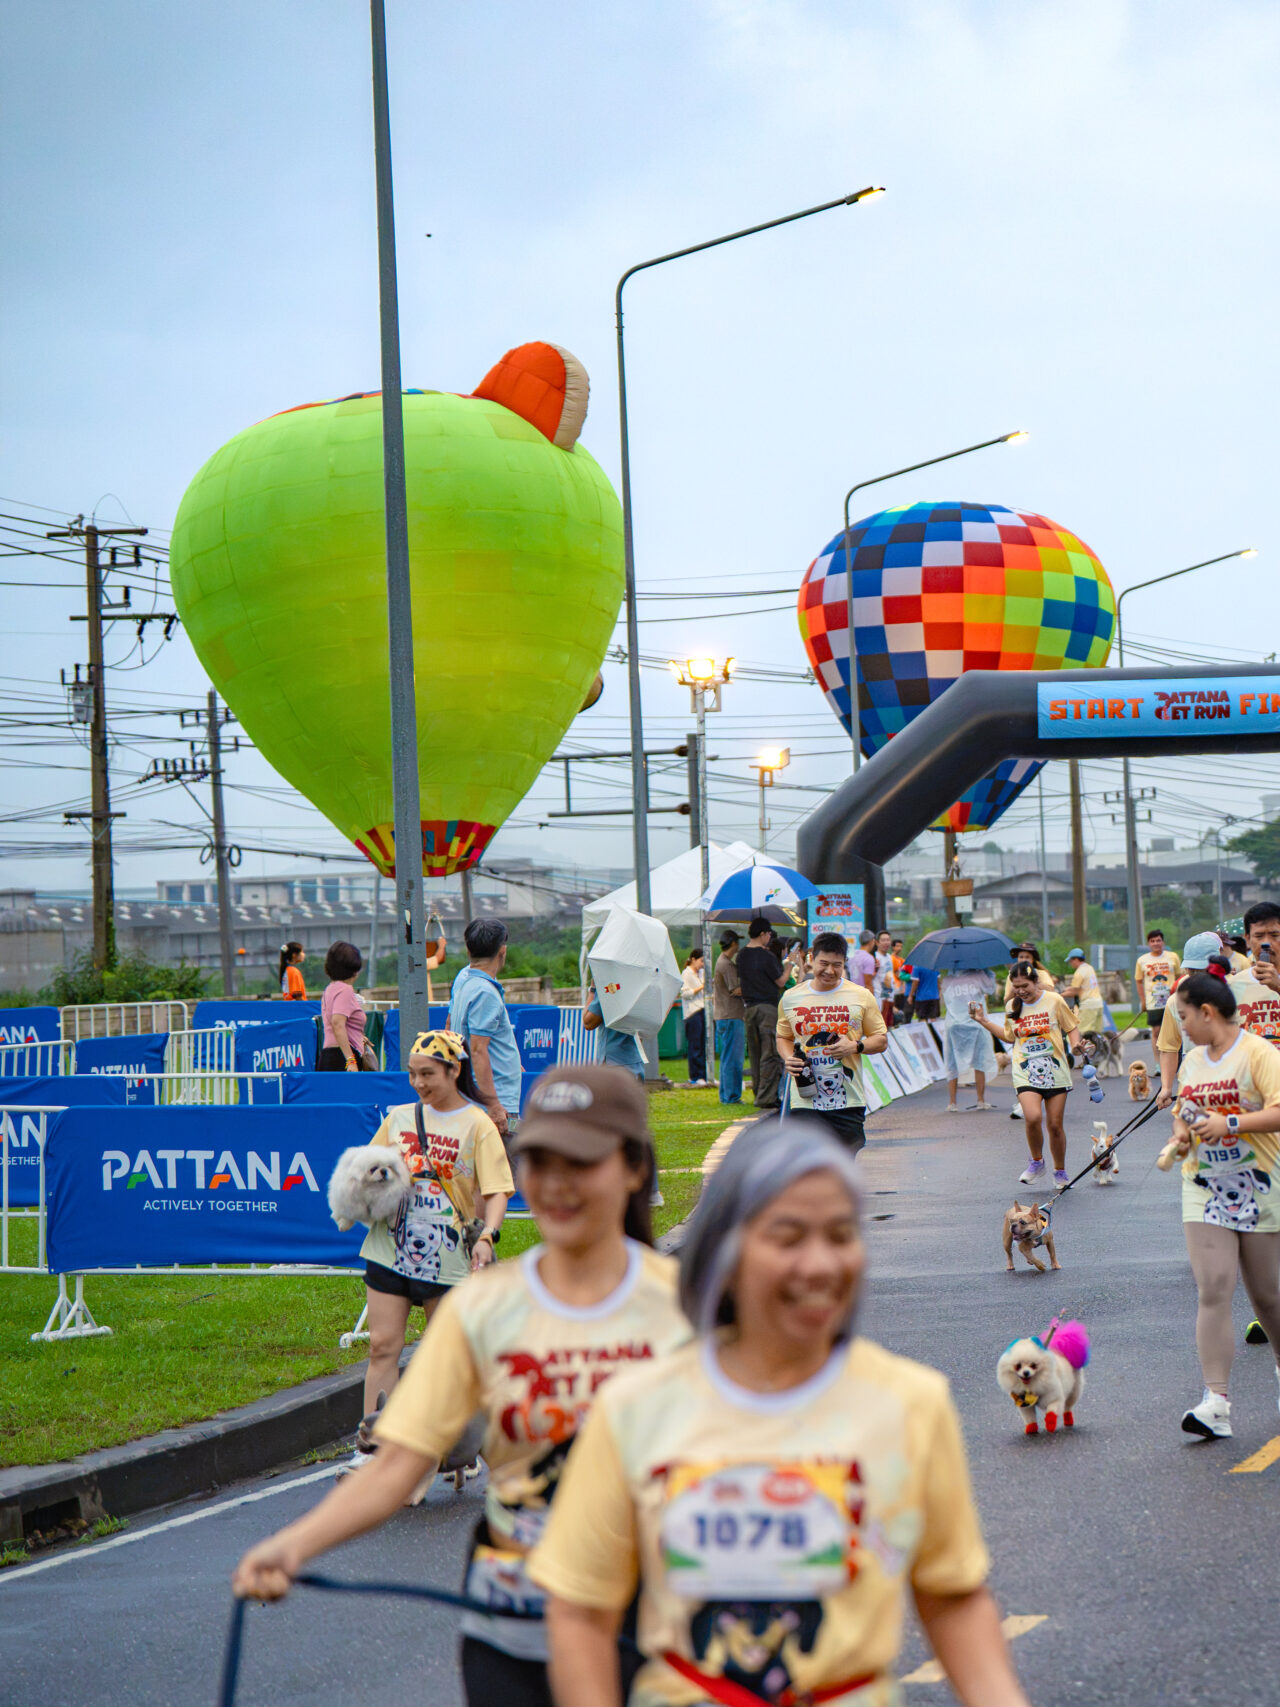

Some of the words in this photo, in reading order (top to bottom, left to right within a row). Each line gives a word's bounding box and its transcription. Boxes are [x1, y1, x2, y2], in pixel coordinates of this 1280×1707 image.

[1050, 698, 1144, 720] START
[1194, 704, 1231, 719] RUN
[825, 1013, 850, 1023] RUN
[524, 1028, 554, 1050] PATTANA
[1026, 1043, 1047, 1053] 1223
[252, 1043, 305, 1073] PATTANA
[1208, 1092, 1240, 1107] RUN
[428, 1146, 458, 1163] RUN
[1205, 1148, 1242, 1163] 1199
[102, 1149, 320, 1192] PATTANA
[143, 1200, 204, 1211] ACTIVELY
[208, 1200, 278, 1213] TOGETHER
